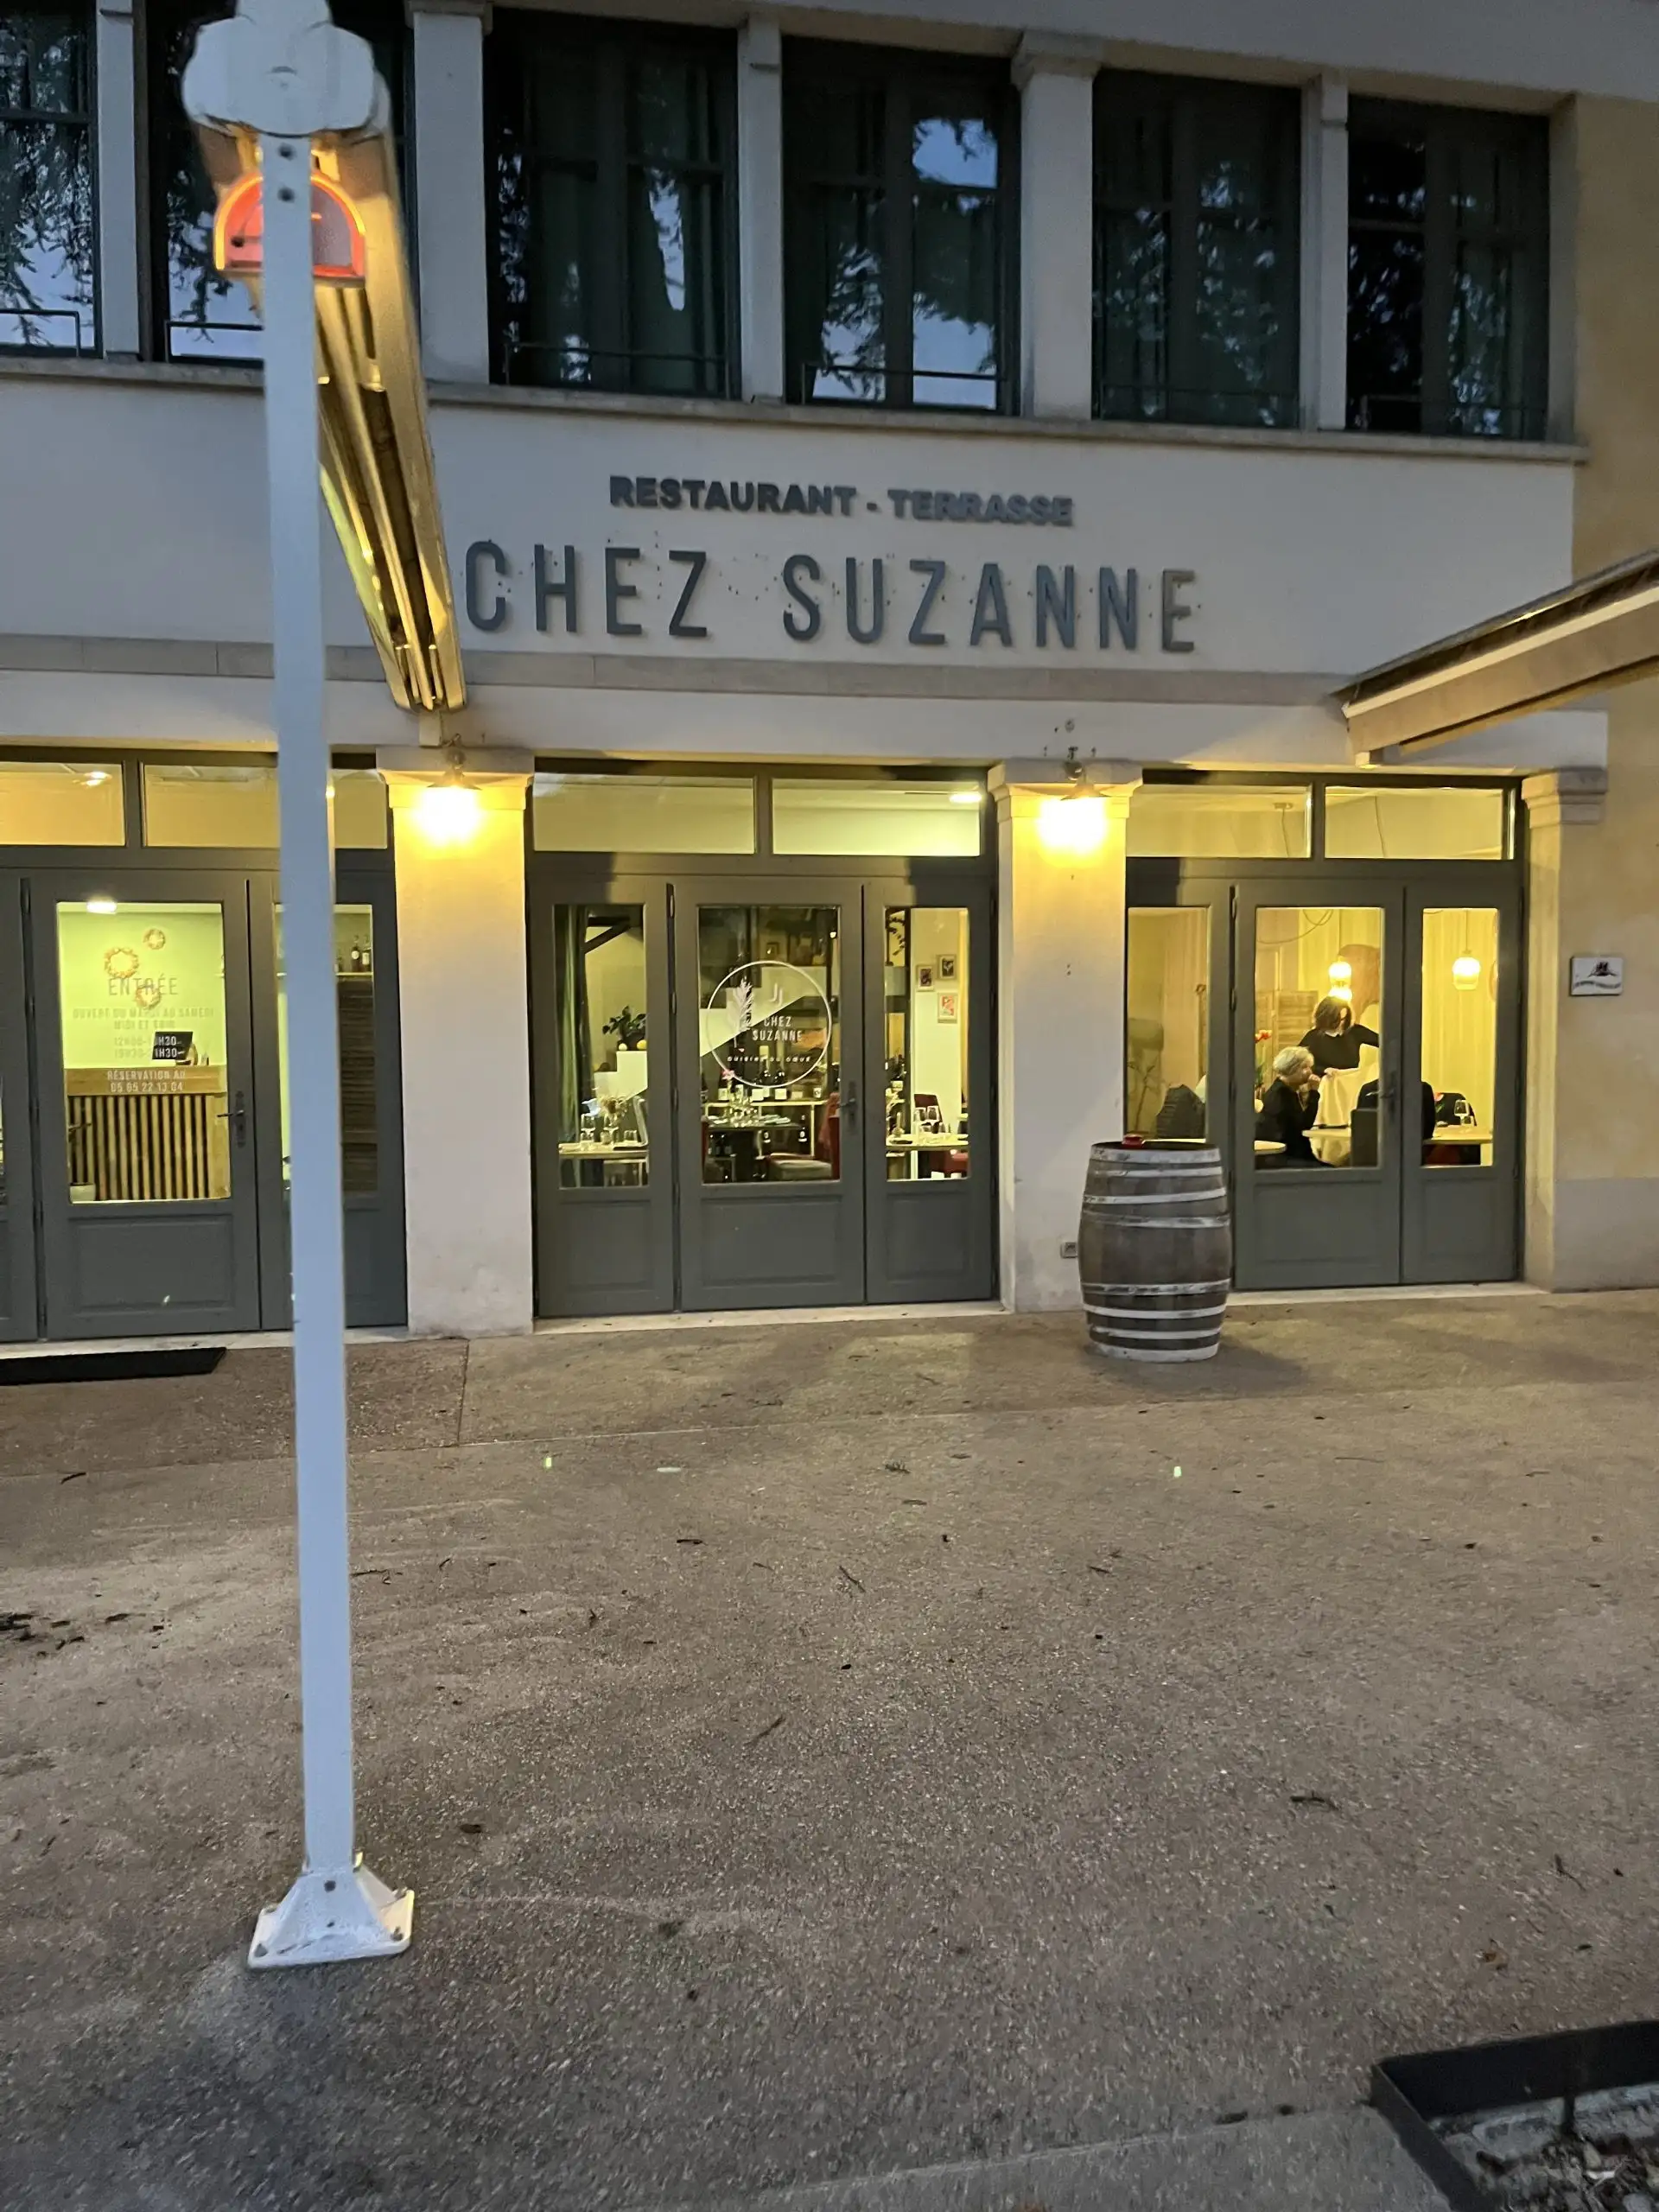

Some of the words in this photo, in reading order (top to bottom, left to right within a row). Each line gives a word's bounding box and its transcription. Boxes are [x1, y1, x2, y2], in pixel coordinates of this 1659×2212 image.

[610, 475, 856, 516] RESTAURANT
[888, 489, 1074, 526] TERRASSE
[466, 540, 708, 639] CHEZ
[782, 554, 1195, 653] SUZANNE
[109, 973, 178, 995] ENTRÉE
[73, 1007, 110, 1019] OUVERT
[764, 1015, 792, 1027] CHEZ
[752, 1029, 803, 1042] SUZANNE
